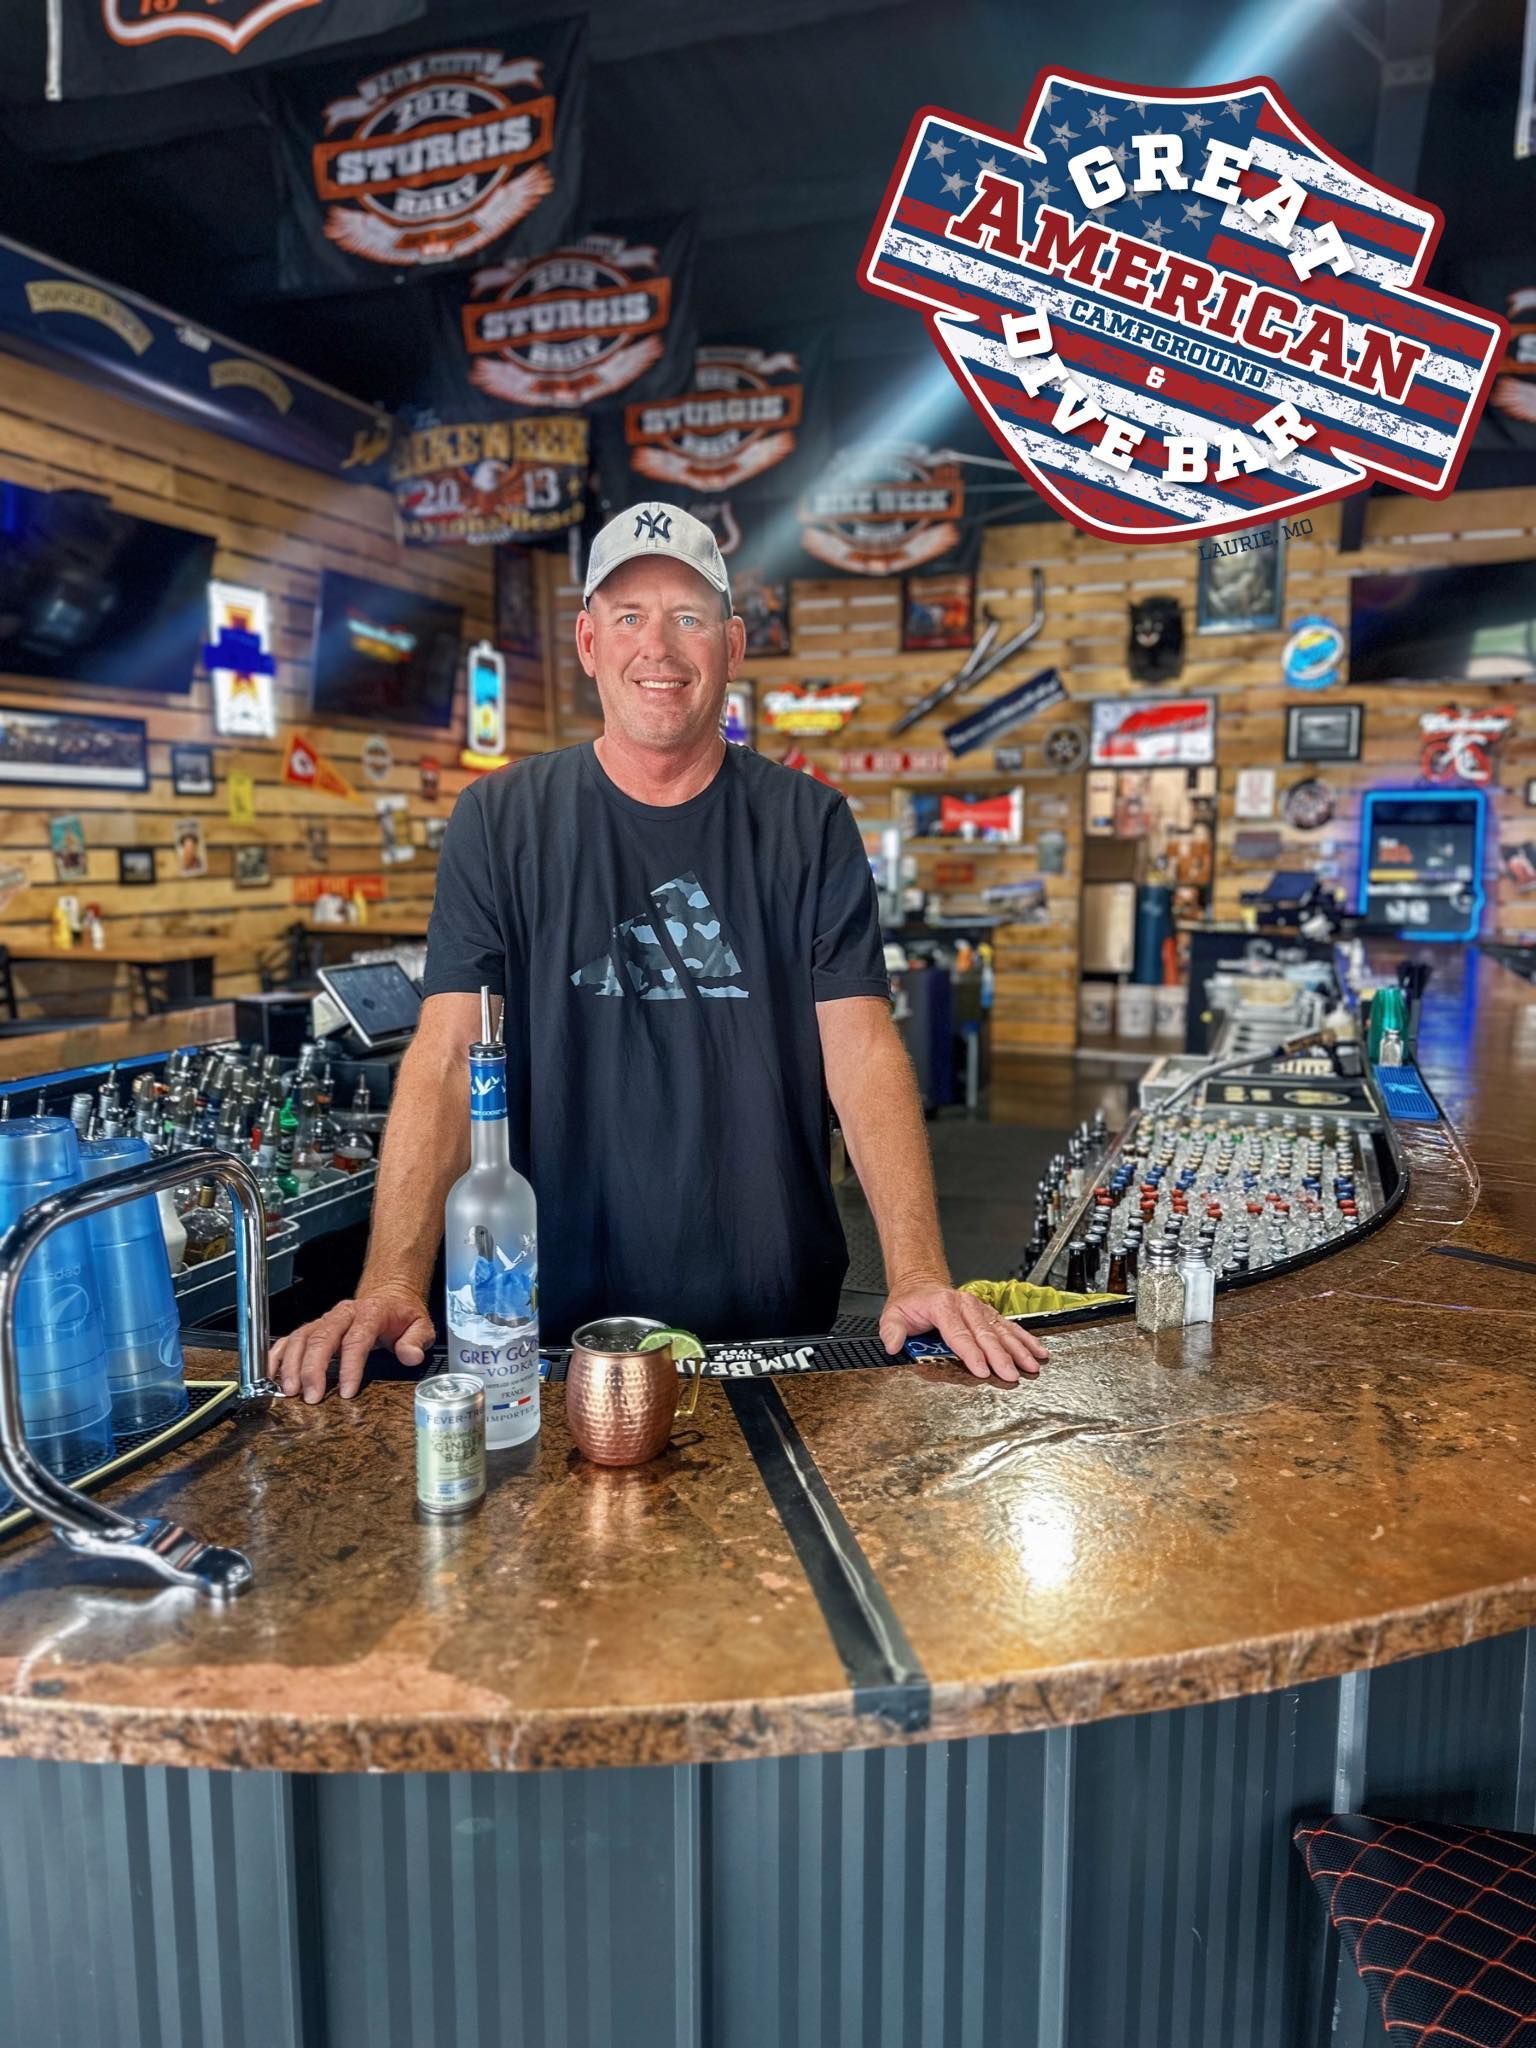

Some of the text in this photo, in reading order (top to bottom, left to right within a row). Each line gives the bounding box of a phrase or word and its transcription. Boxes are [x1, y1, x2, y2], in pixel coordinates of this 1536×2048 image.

[397, 89, 471, 122] 2014
[334, 113, 534, 187] STURGIS
[394, 174, 479, 216] RALLY
[480, 291, 650, 342] STURGIS
[640, 394, 784, 436] STURGIS
[413, 467, 562, 517] 20 13
[633, 509, 673, 543] NY
[459, 1338, 539, 1366] GREY GOO
[486, 1358, 534, 1378] VODKA
[757, 1346, 815, 1373] JIM
